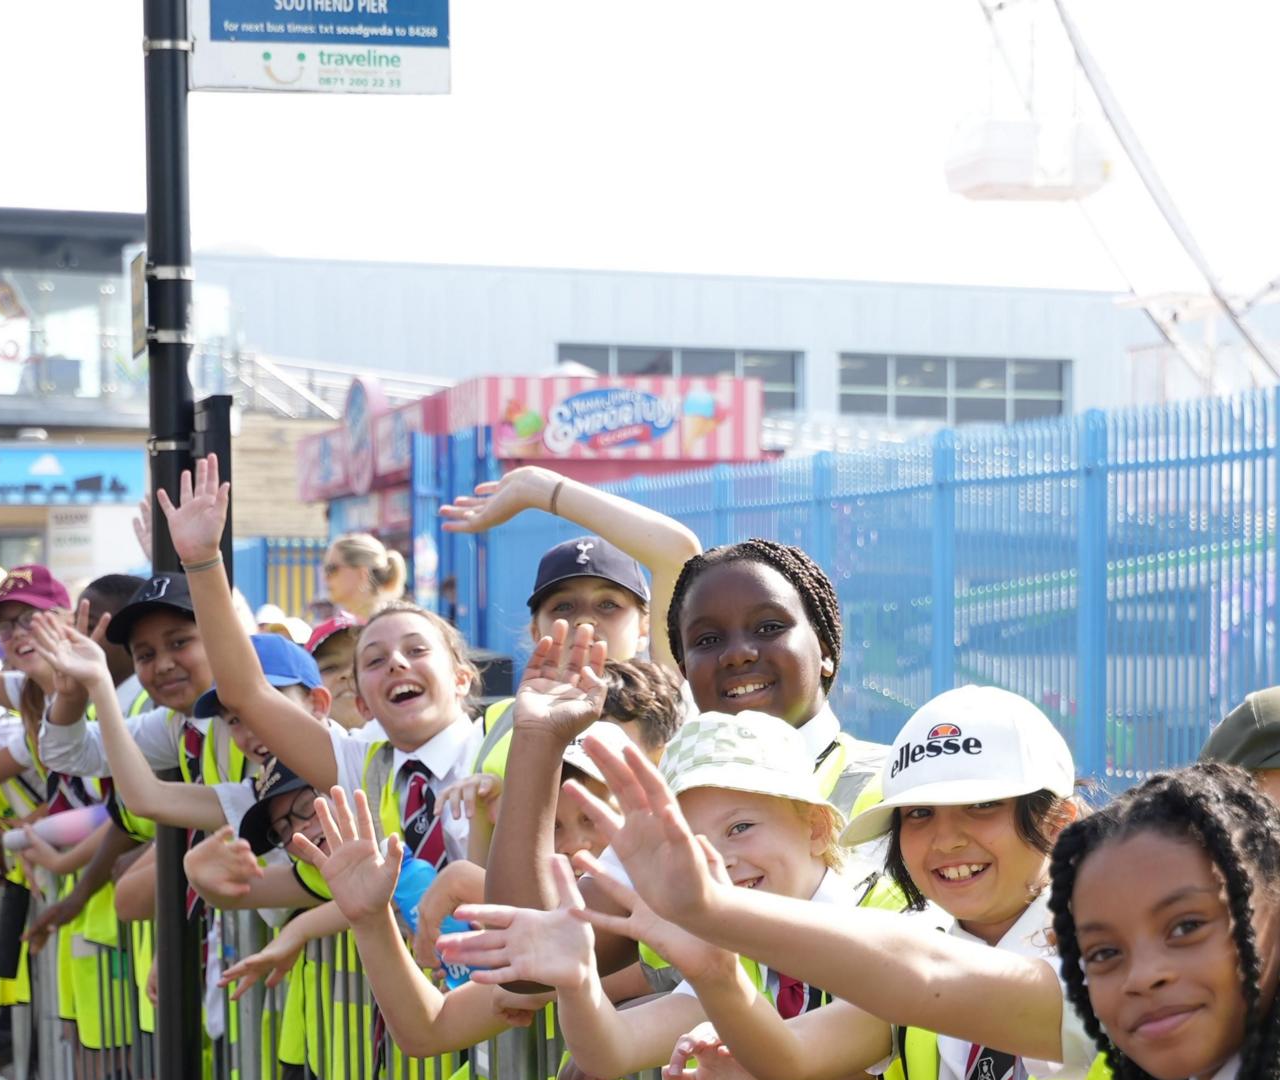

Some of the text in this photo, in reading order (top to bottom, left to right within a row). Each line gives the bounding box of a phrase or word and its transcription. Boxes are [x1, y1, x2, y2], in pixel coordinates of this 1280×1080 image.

[273, 0, 389, 14] SOUTHEND PIER
[223, 20, 240, 32] for
[241, 23, 265, 33] next
[266, 21, 285, 33] bus
[318, 24, 335, 35] txt
[395, 26, 407, 37] to
[318, 49, 402, 68] traveline
[891, 737, 983, 779] ellesse
